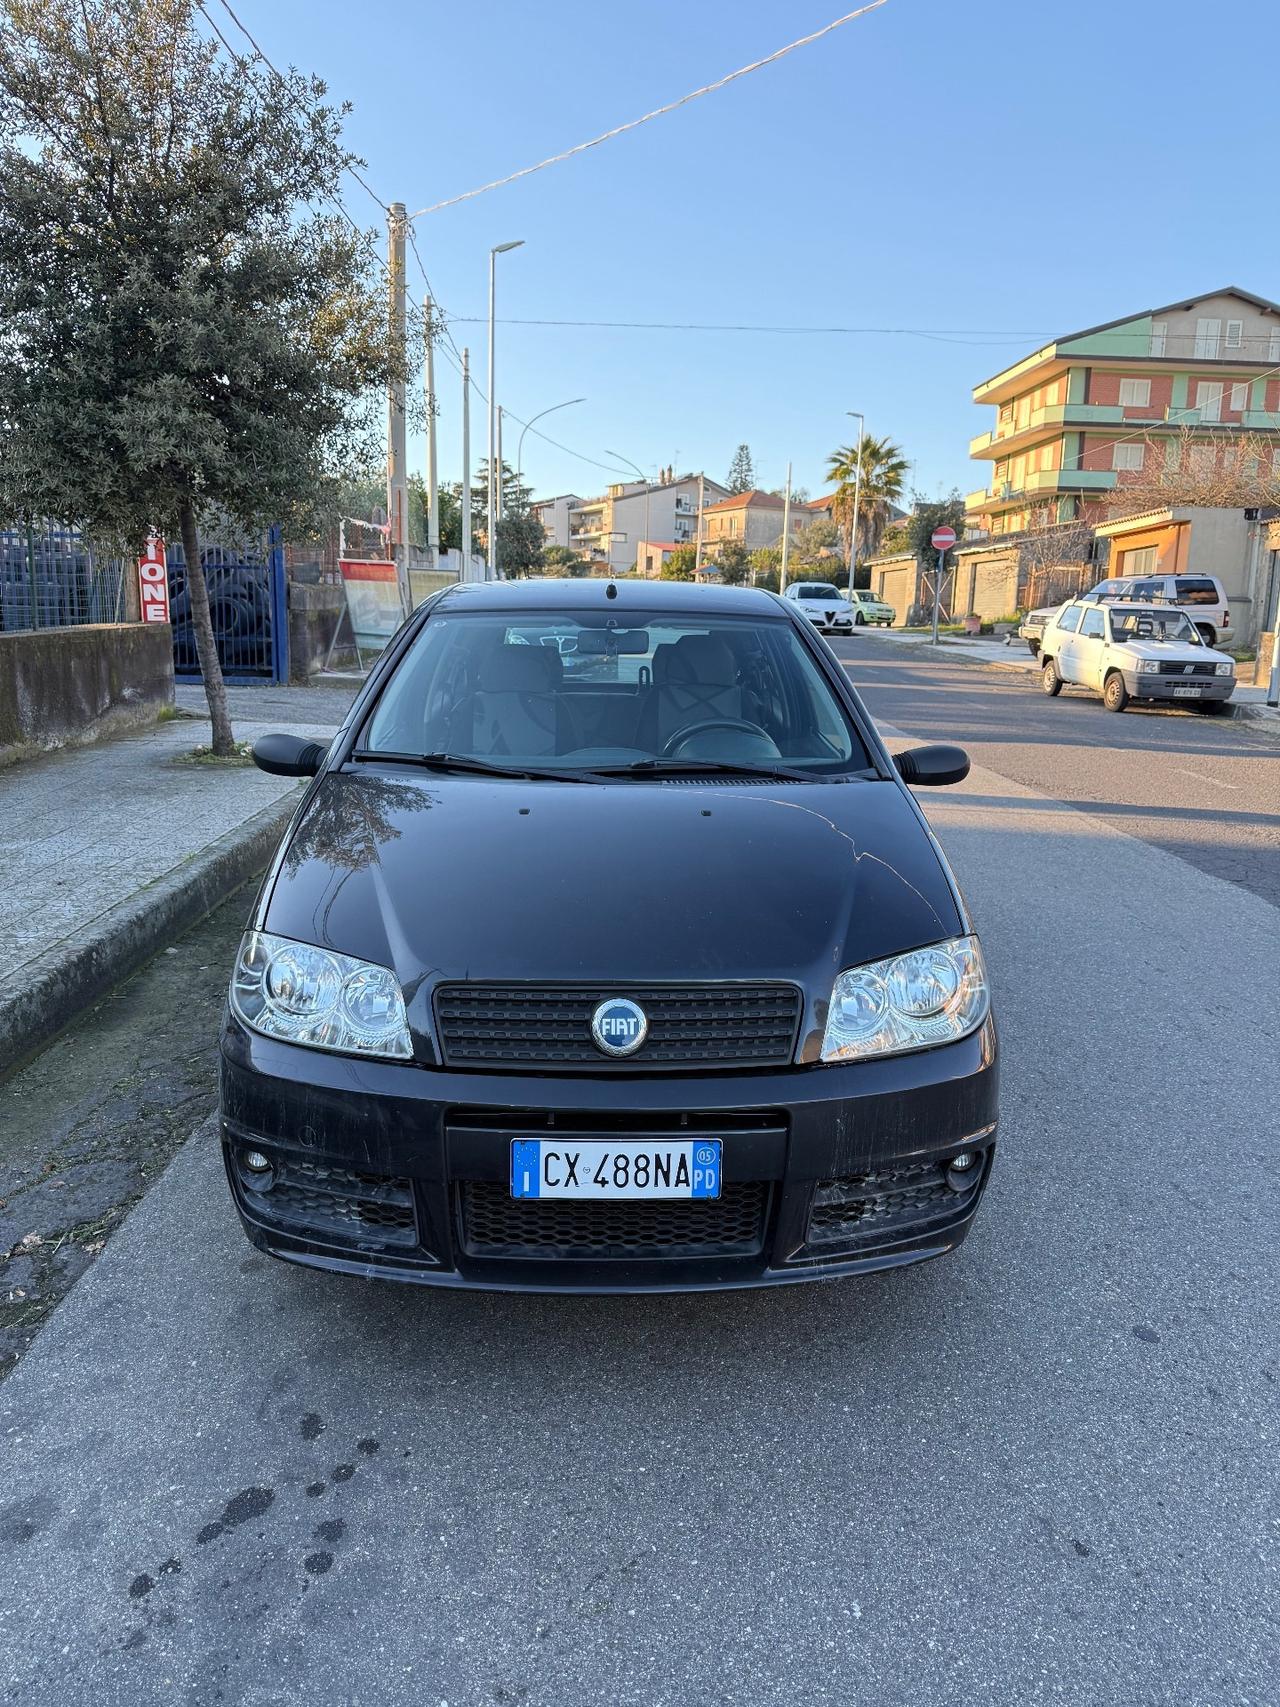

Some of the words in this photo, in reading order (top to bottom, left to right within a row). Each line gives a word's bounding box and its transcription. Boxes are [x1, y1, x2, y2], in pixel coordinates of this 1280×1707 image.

[602, 1018, 637, 1036] FIAT
[699, 1151, 711, 1161] 05
[544, 1152, 580, 1188] CX
[593, 1152, 691, 1188] 488NA
[693, 1169, 716, 1190] PD
[523, 1171, 530, 1192] I
